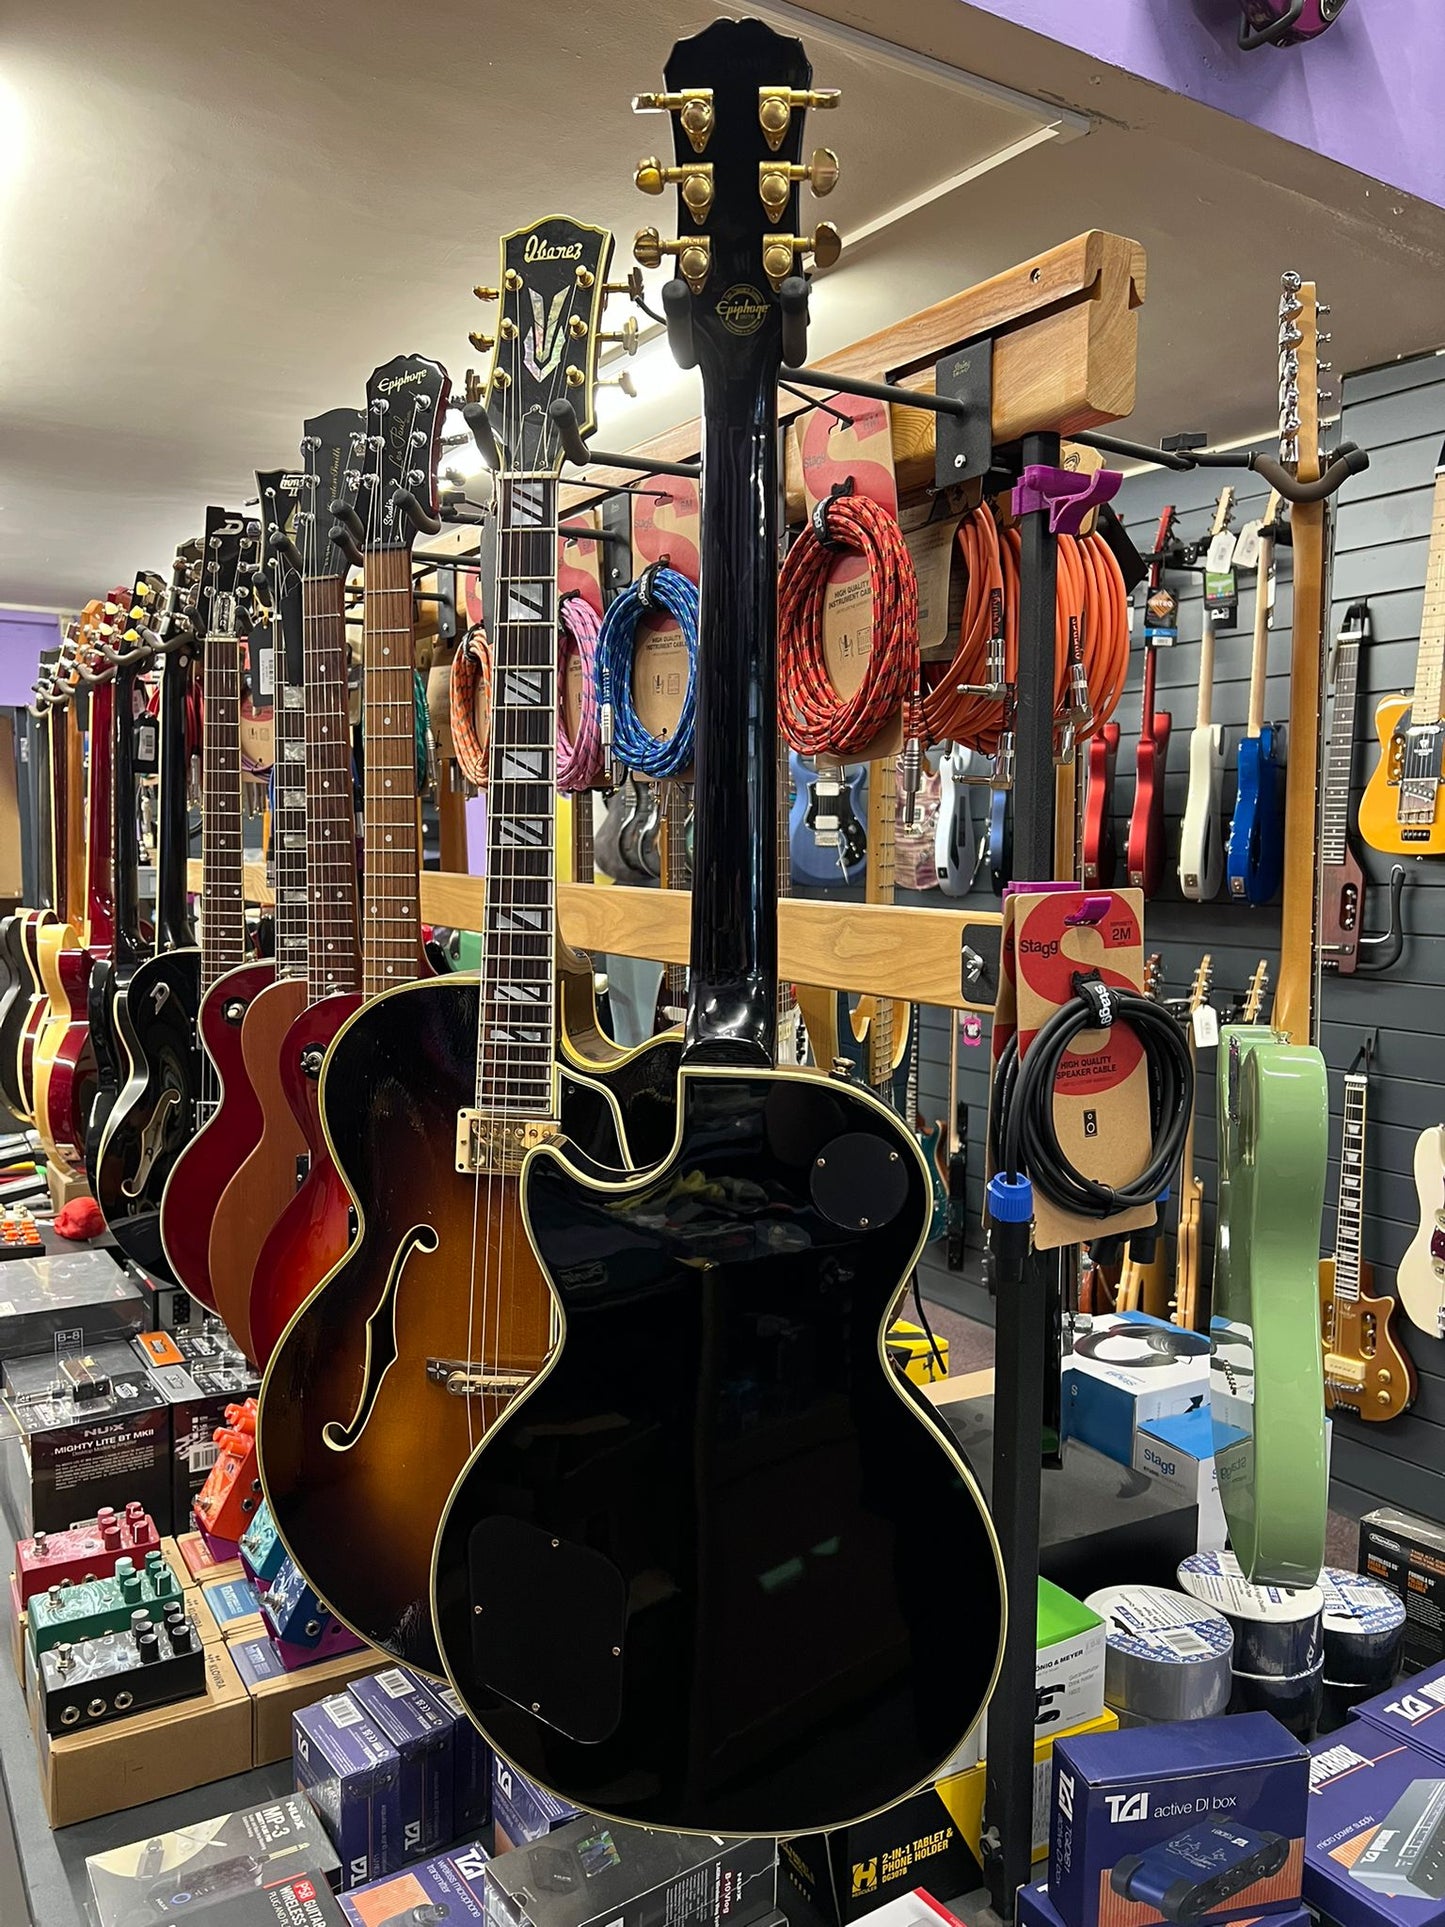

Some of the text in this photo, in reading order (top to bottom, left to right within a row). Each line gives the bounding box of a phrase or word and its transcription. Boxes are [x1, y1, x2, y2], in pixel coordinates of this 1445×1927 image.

[524, 234, 583, 263] Ibanez
[715, 299, 771, 321] Epiphone
[377, 368, 428, 395] Epiphone
[383, 498, 394, 527] Studio
[828, 592, 861, 610] INSTRUMENT
[860, 588, 871, 599] CAB
[847, 580, 870, 595] QUALITY
[664, 635, 681, 643] QUALITY
[1020, 939, 1058, 959] Stagg
[1111, 928, 1131, 942] 2M
[1095, 984, 1113, 1025] Stagg
[1056, 1064, 1117, 1079] SPEAKER CABLE
[1060, 1056, 1112, 1070] HIGH QUALITY
[57, 1331, 80, 1342] B-8
[54, 1428, 154, 1455] MIGHTY LITE BT MKII
[1144, 1448, 1175, 1475] Stagg
[1194, 1622, 1224, 1637] EAGLE
[1060, 1649, 1083, 1663] MEYER
[207, 1661, 227, 1690] KLOWRA
[1383, 1694, 1434, 1722] TGI
[1309, 1744, 1375, 1794] OWERBOX
[1058, 1768, 1075, 1823] TGI
[1105, 1792, 1237, 1823] TGI active DI box
[262, 1805, 291, 1838] MP-3
[1316, 1837, 1335, 1851] micro
[1334, 1825, 1355, 1841] power
[1352, 1815, 1375, 1830] supply
[882, 1827, 954, 1864] 2-IN-1 TABLET &
[882, 1839, 949, 1875] PHONE HOLDER
[351, 1855, 367, 1888] TGI
[454, 1847, 488, 1881] TGI
[295, 1882, 314, 1899] P58
[426, 1864, 451, 1894] transmitter
[437, 1859, 481, 1919] wireless microphone
[722, 1872, 732, 1914] B-10 Vlog
[851, 1886, 878, 1898] HERCULES
[268, 1890, 282, 1908] PLUG
[275, 1905, 287, 1921] AND
[279, 1884, 307, 1926] WIRELESS
